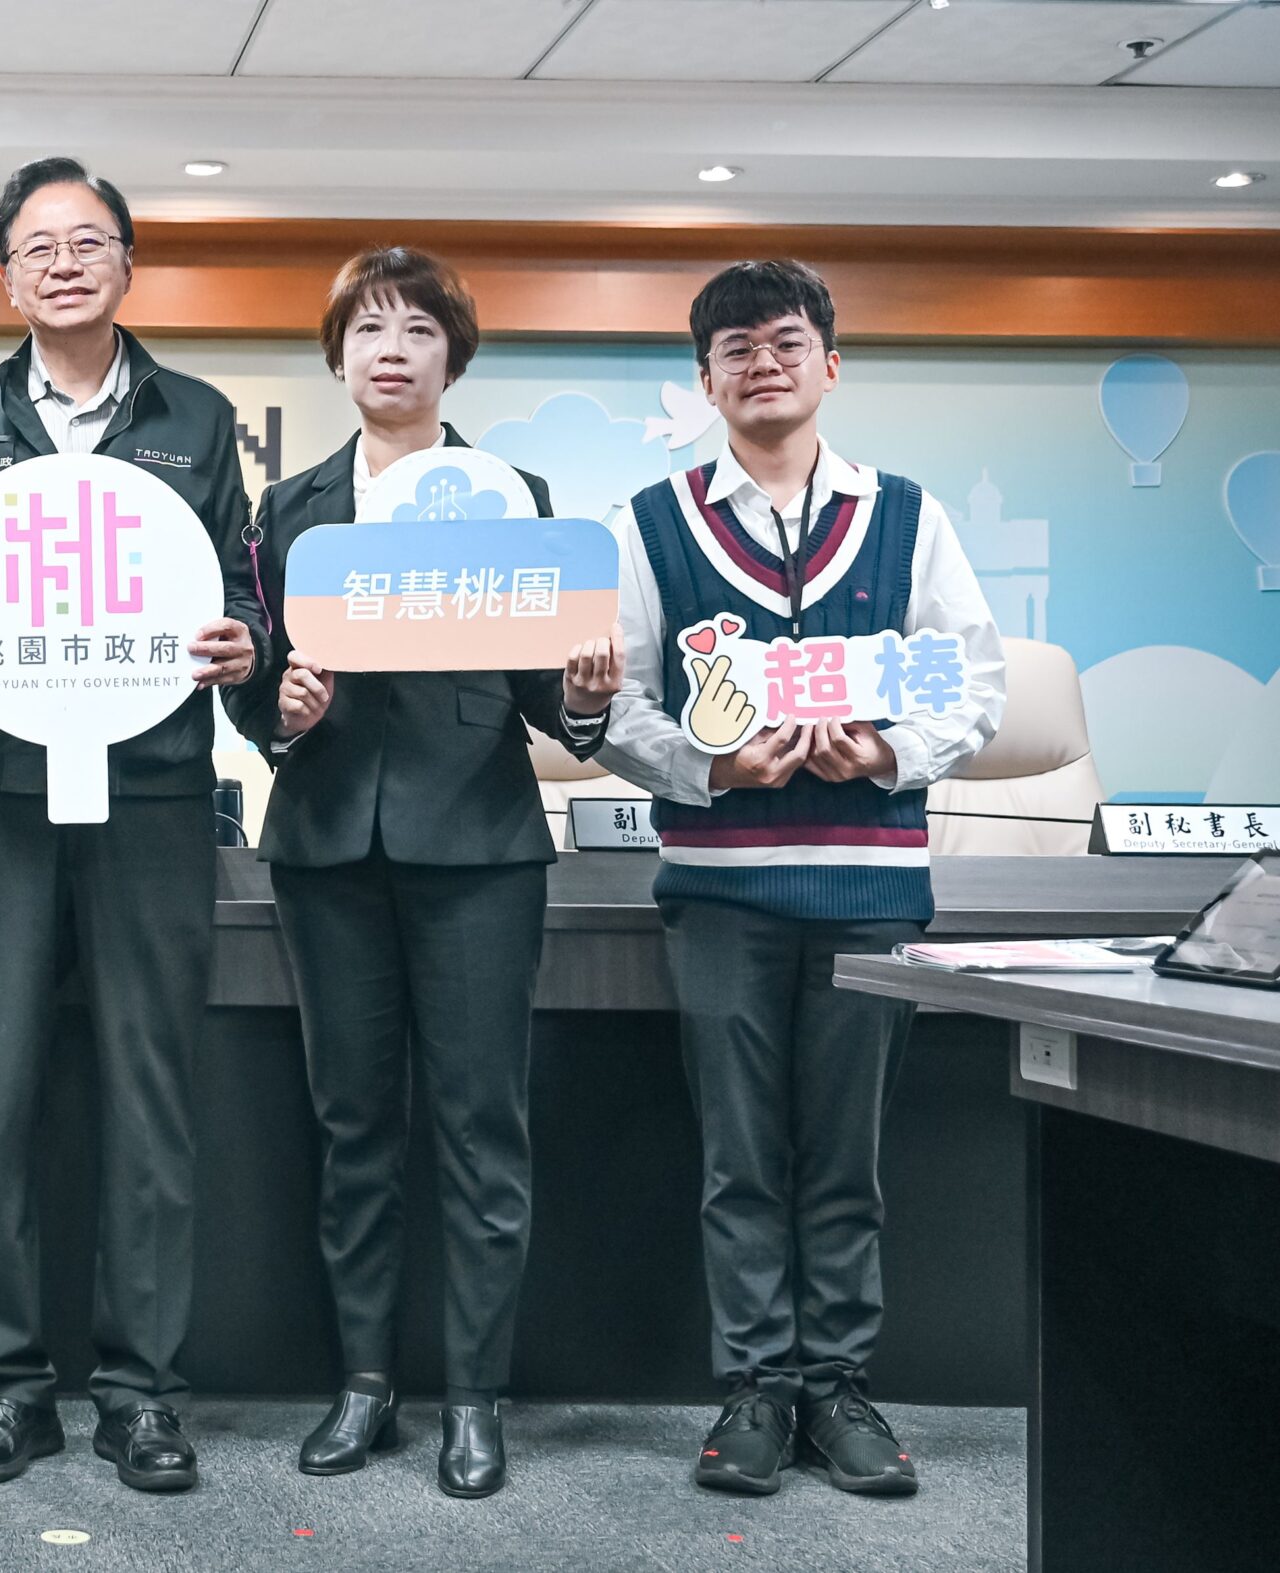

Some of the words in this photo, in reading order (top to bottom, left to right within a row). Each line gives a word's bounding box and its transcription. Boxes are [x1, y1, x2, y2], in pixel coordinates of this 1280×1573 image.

[135, 448, 192, 463] TAOYUAN
[342, 566, 561, 620] 智慧桃園
[46, 678, 77, 689] CITY
[83, 676, 181, 688] GOVERNMENT
[1128, 811, 1270, 838] 副秘書長
[622, 833, 660, 844] Deput
[1123, 838, 1166, 849] Deputy
